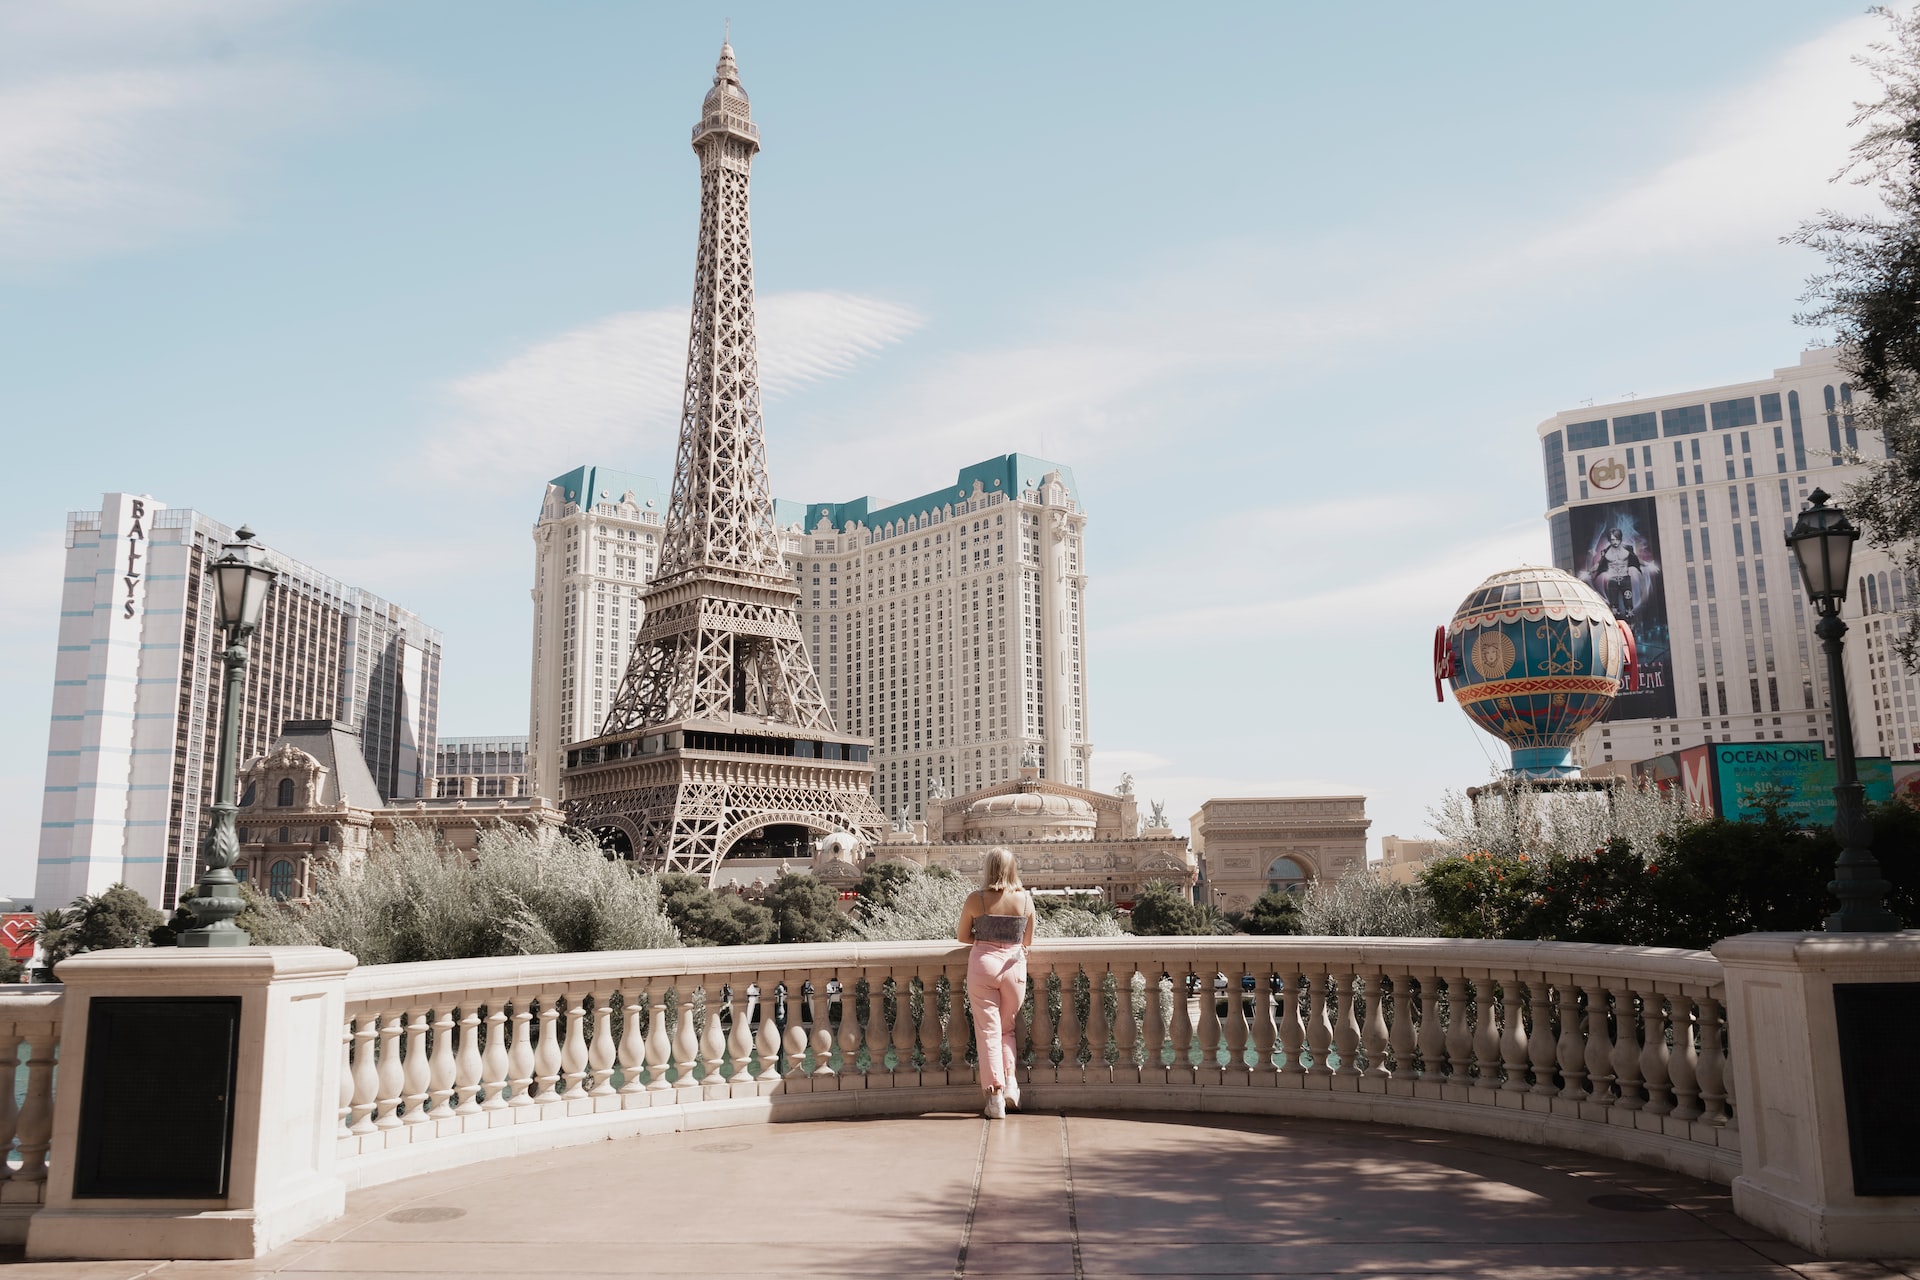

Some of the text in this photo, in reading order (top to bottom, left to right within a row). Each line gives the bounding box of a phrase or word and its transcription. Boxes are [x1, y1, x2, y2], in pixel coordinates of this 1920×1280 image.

[1721, 748, 1818, 765] OCEAN ONE
[1734, 767, 1755, 777] BAR
[1761, 767, 1769, 777] &
[1735, 782, 1742, 793] 3
[1754, 782, 1773, 794] $10
